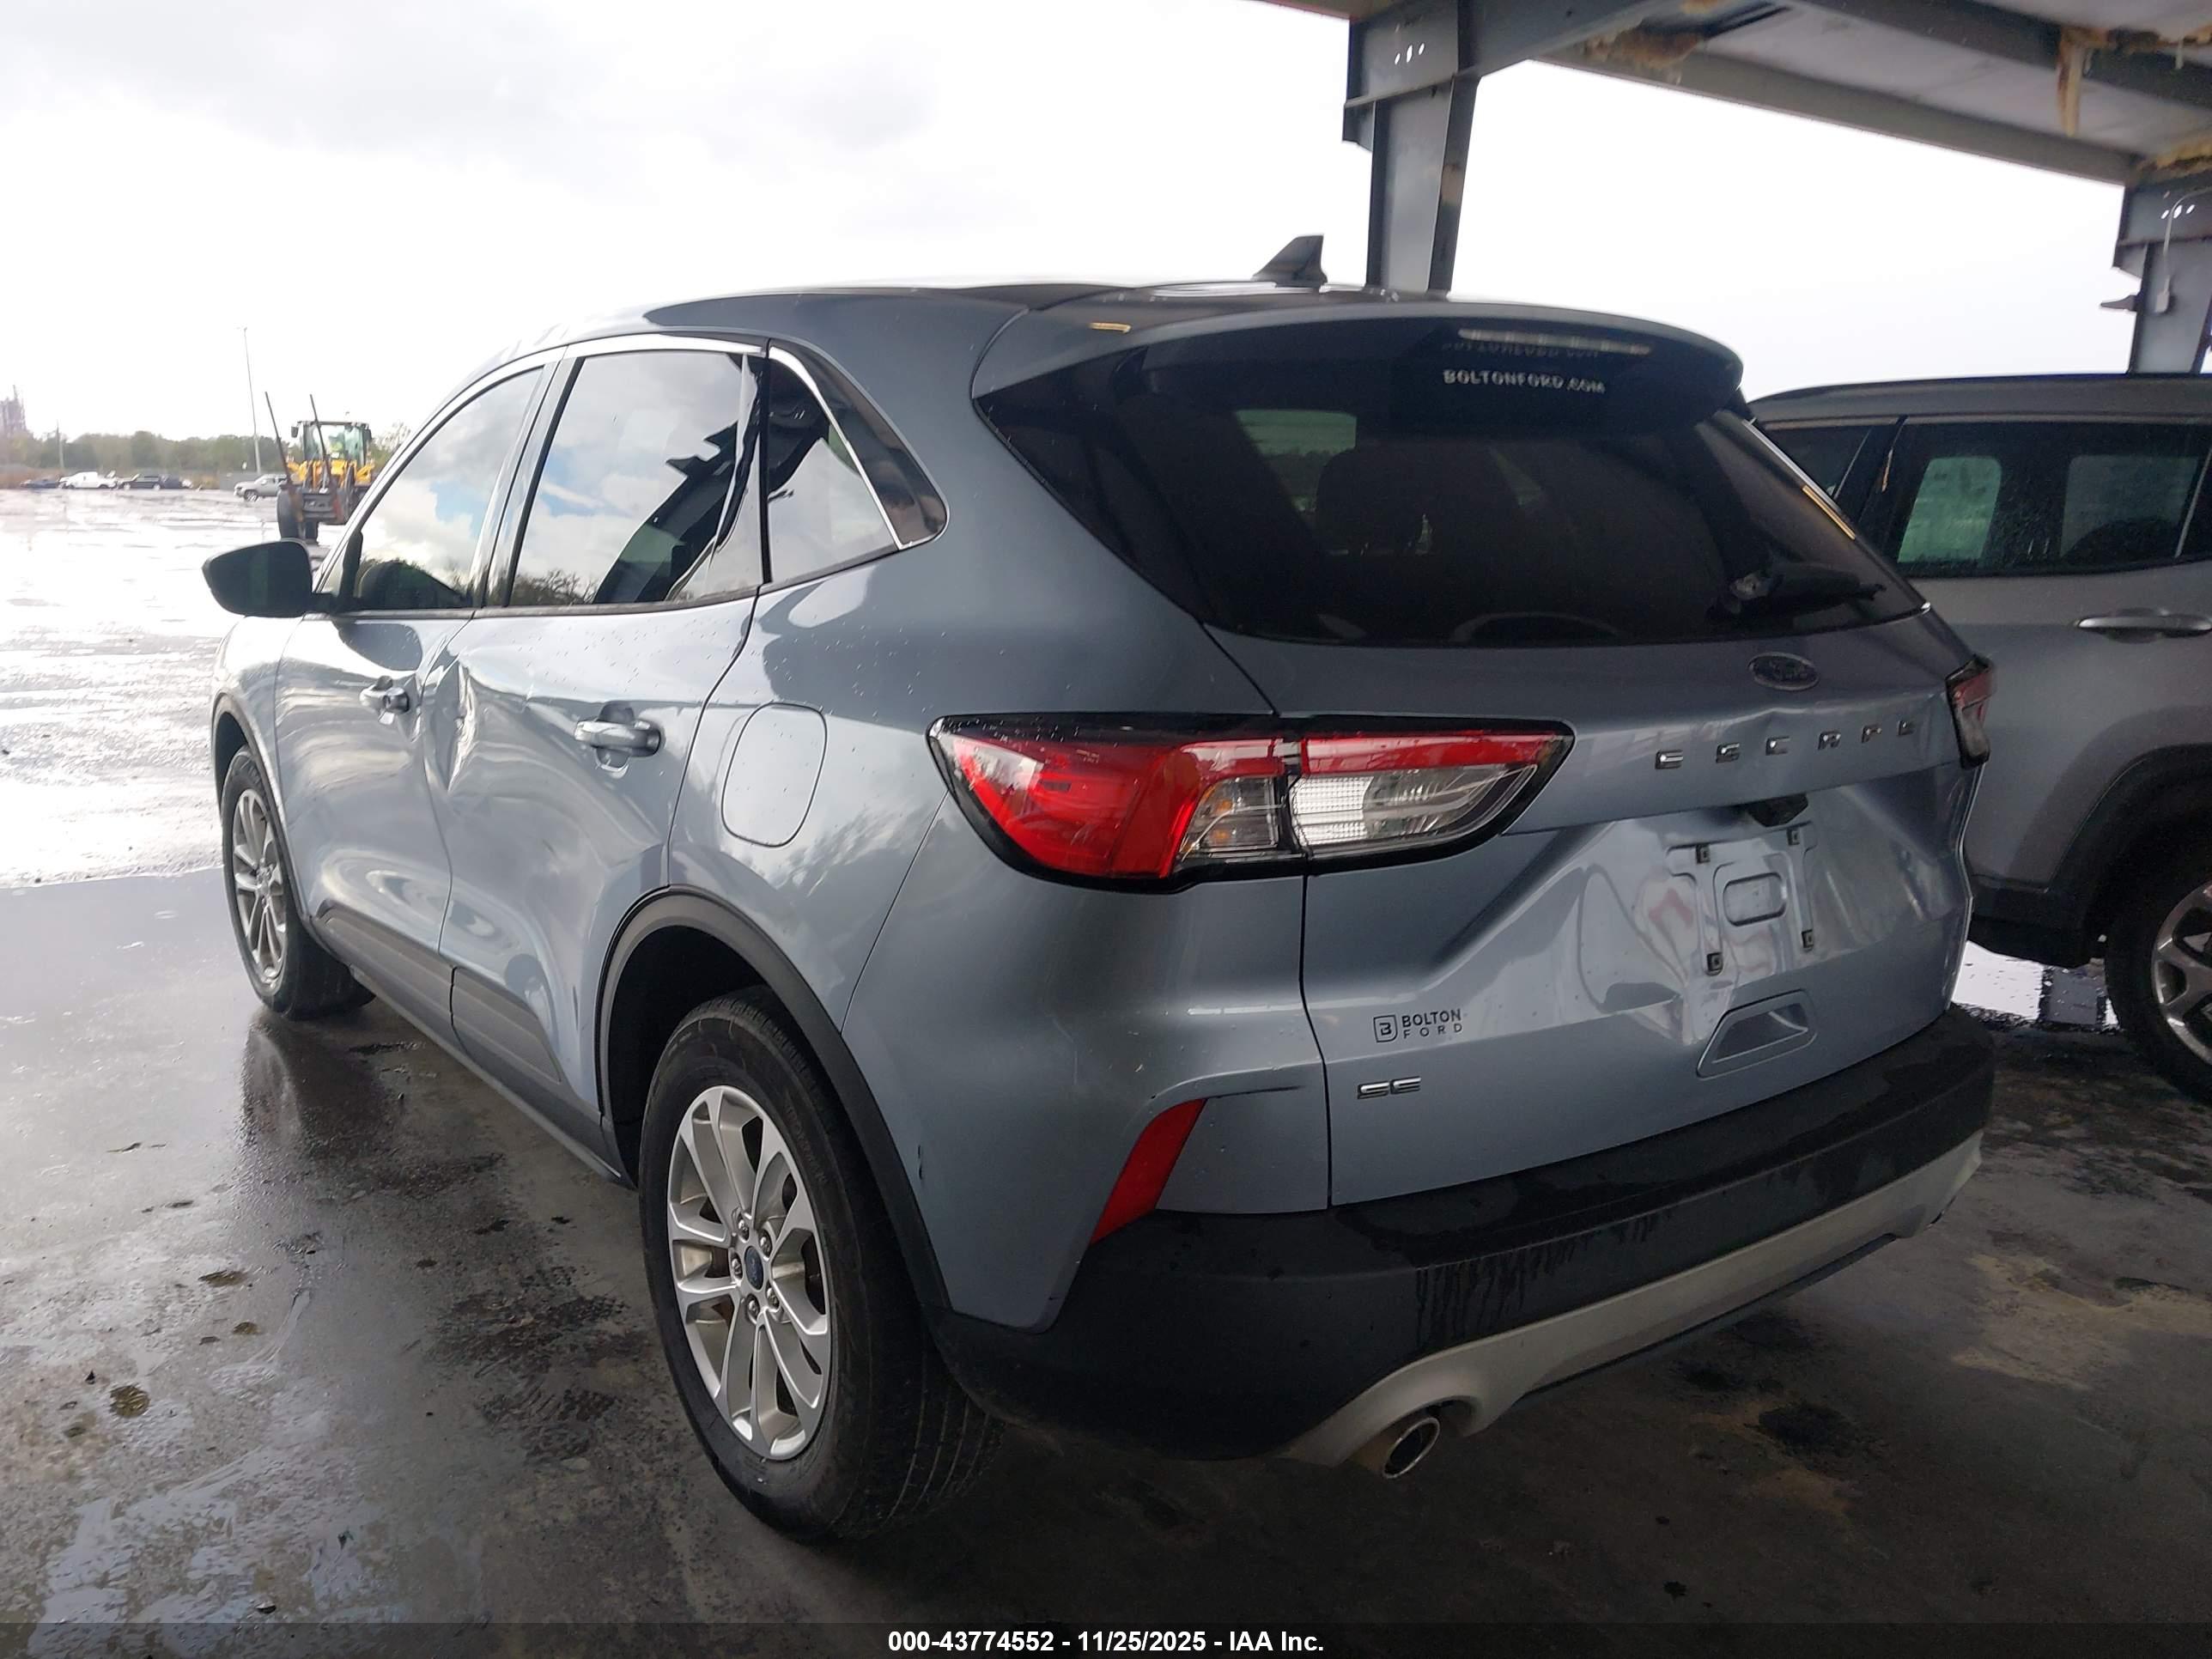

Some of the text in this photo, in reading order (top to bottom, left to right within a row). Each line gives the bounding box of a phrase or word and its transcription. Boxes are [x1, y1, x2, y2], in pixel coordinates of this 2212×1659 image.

[1401, 1008, 1462, 1028] BOLTON
[1403, 1023, 1462, 1039] FORD
[1357, 1076, 1421, 1100] SE
